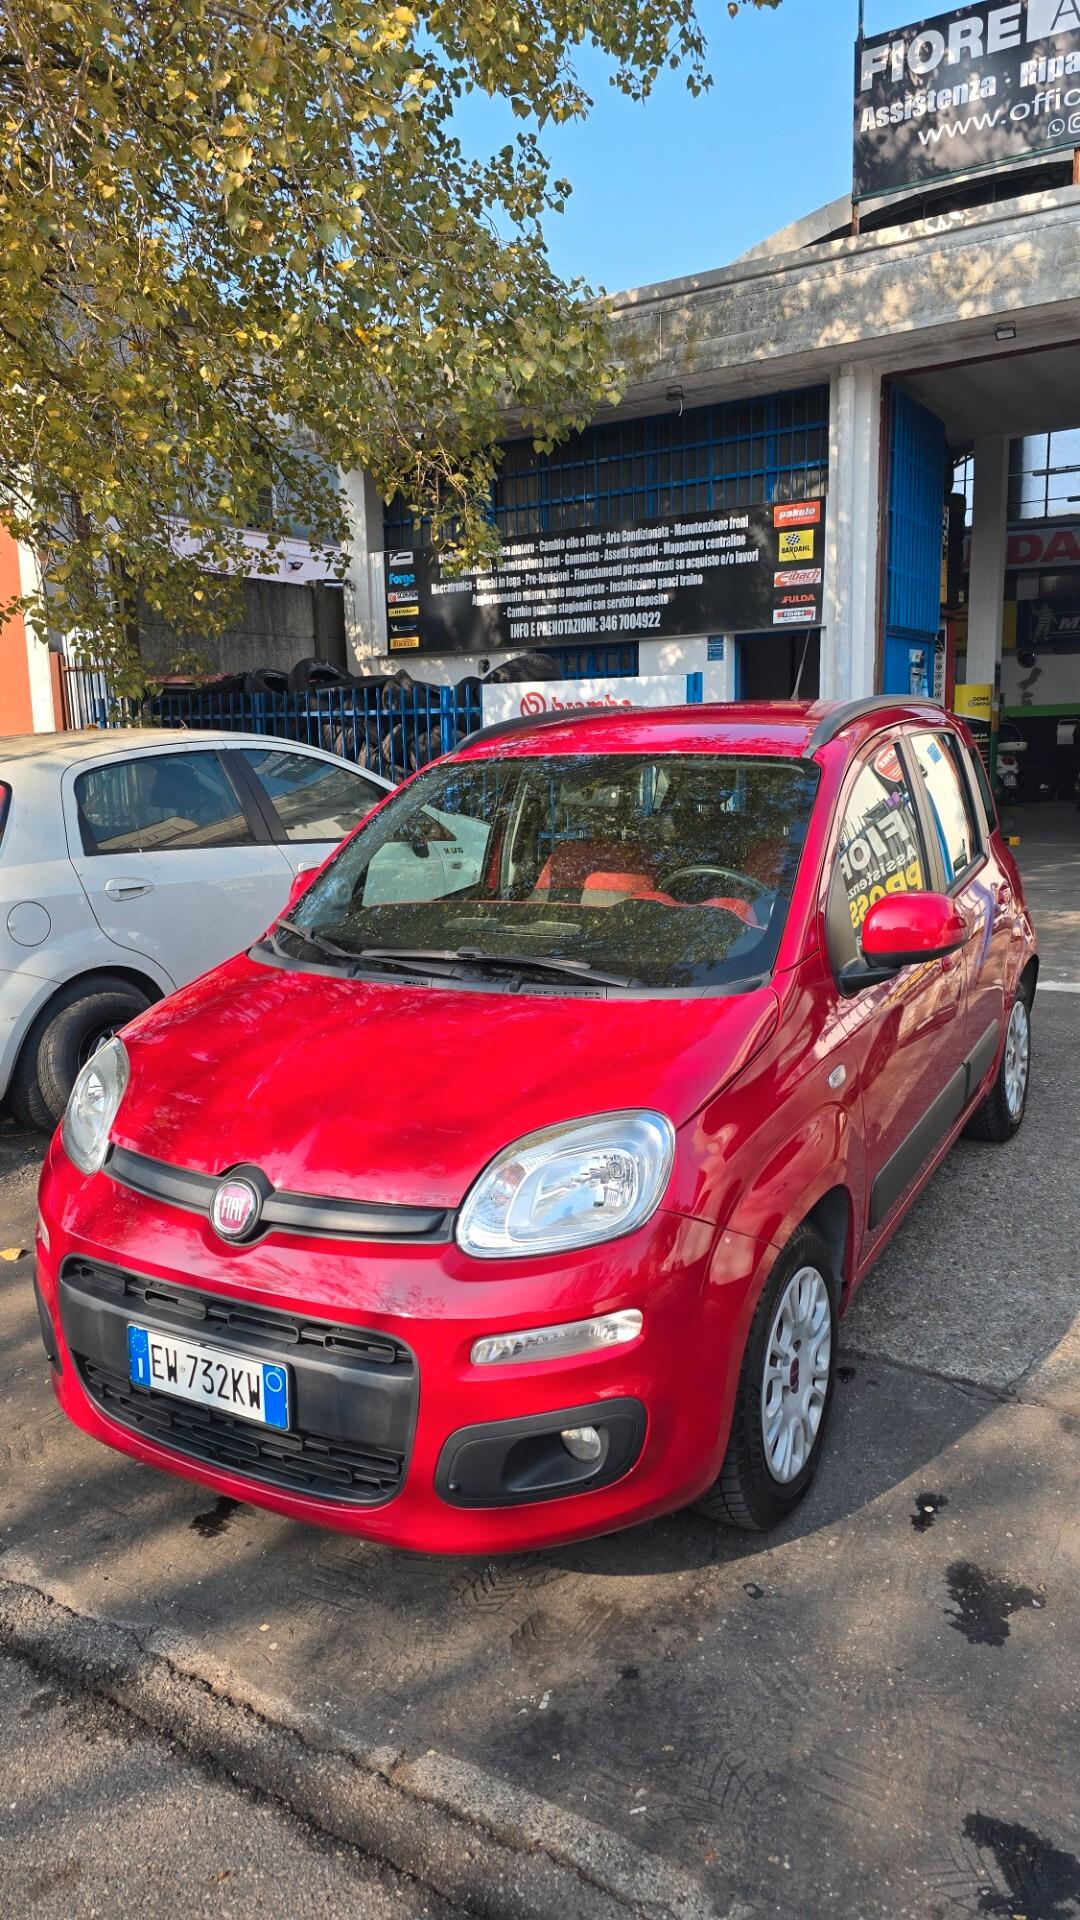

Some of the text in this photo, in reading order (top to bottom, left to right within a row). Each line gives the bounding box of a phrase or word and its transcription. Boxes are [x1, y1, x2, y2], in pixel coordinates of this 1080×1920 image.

[861, 3, 1021, 92] FIORE
[860, 75, 997, 132] Assistenza
[540, 539, 565, 552] Cambio
[566, 536, 579, 549] olio
[580, 538, 586, 547] e
[586, 533, 602, 546] filtri
[606, 532, 620, 545] Aria
[622, 526, 669, 542] Condizionata
[674, 519, 728, 537] Manutenzione
[729, 514, 749, 529] freni
[544, 555, 560, 567] freni
[565, 551, 600, 565] Gommista
[604, 546, 629, 560] Assetti
[630, 543, 658, 559] sportivi
[663, 540, 704, 554] Mappature
[706, 534, 746, 549] centraline
[781, 545, 811, 554] BARDAHL
[506, 575, 521, 589] lega
[574, 563, 622, 580] Finanziamenti
[623, 558, 674, 577] personalizzati
[675, 559, 685, 570] su
[686, 554, 719, 569] acquisto
[720, 552, 734, 565] e/o
[735, 548, 759, 564] lavori
[780, 568, 820, 580] Eibach
[566, 583, 605, 598] maggiorate
[610, 577, 656, 593] Installazione
[657, 574, 679, 590] ganci
[680, 573, 703, 587] traino
[782, 594, 816, 604] FULDA
[506, 605, 532, 618] Cambio
[558, 599, 592, 614] stagionali
[593, 600, 606, 610] con
[607, 596, 634, 609] servizio
[635, 593, 669, 607] deposito
[510, 611, 661, 638] INFO E PRENOTAZIONI: 346 7004922
[221, 1195, 248, 1222] FIAT
[186, 1354, 261, 1410] 732KW
